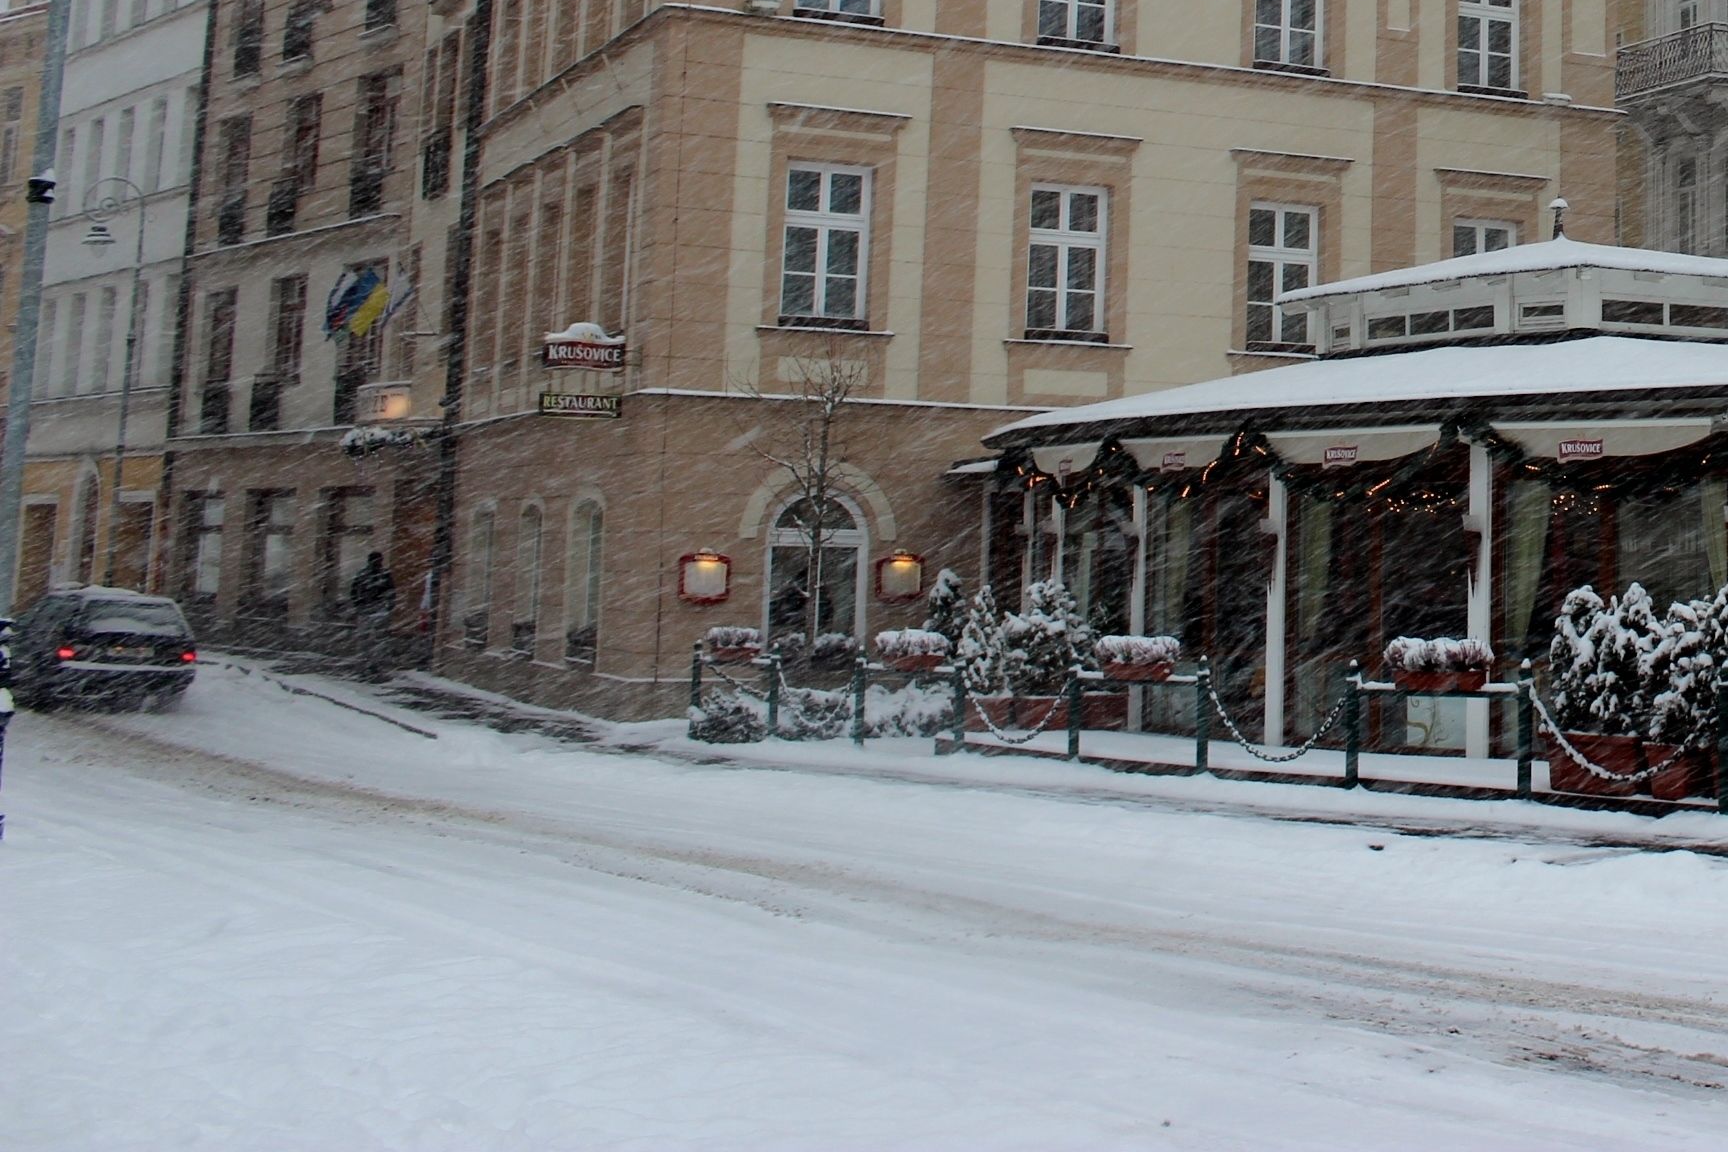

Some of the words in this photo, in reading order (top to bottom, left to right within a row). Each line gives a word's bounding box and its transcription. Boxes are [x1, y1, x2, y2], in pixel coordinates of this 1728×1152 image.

[548, 344, 621, 362] KRUŠOVICE
[543, 395, 618, 409] RESTAURANT
[1561, 442, 1601, 454] KRUŠOVICE
